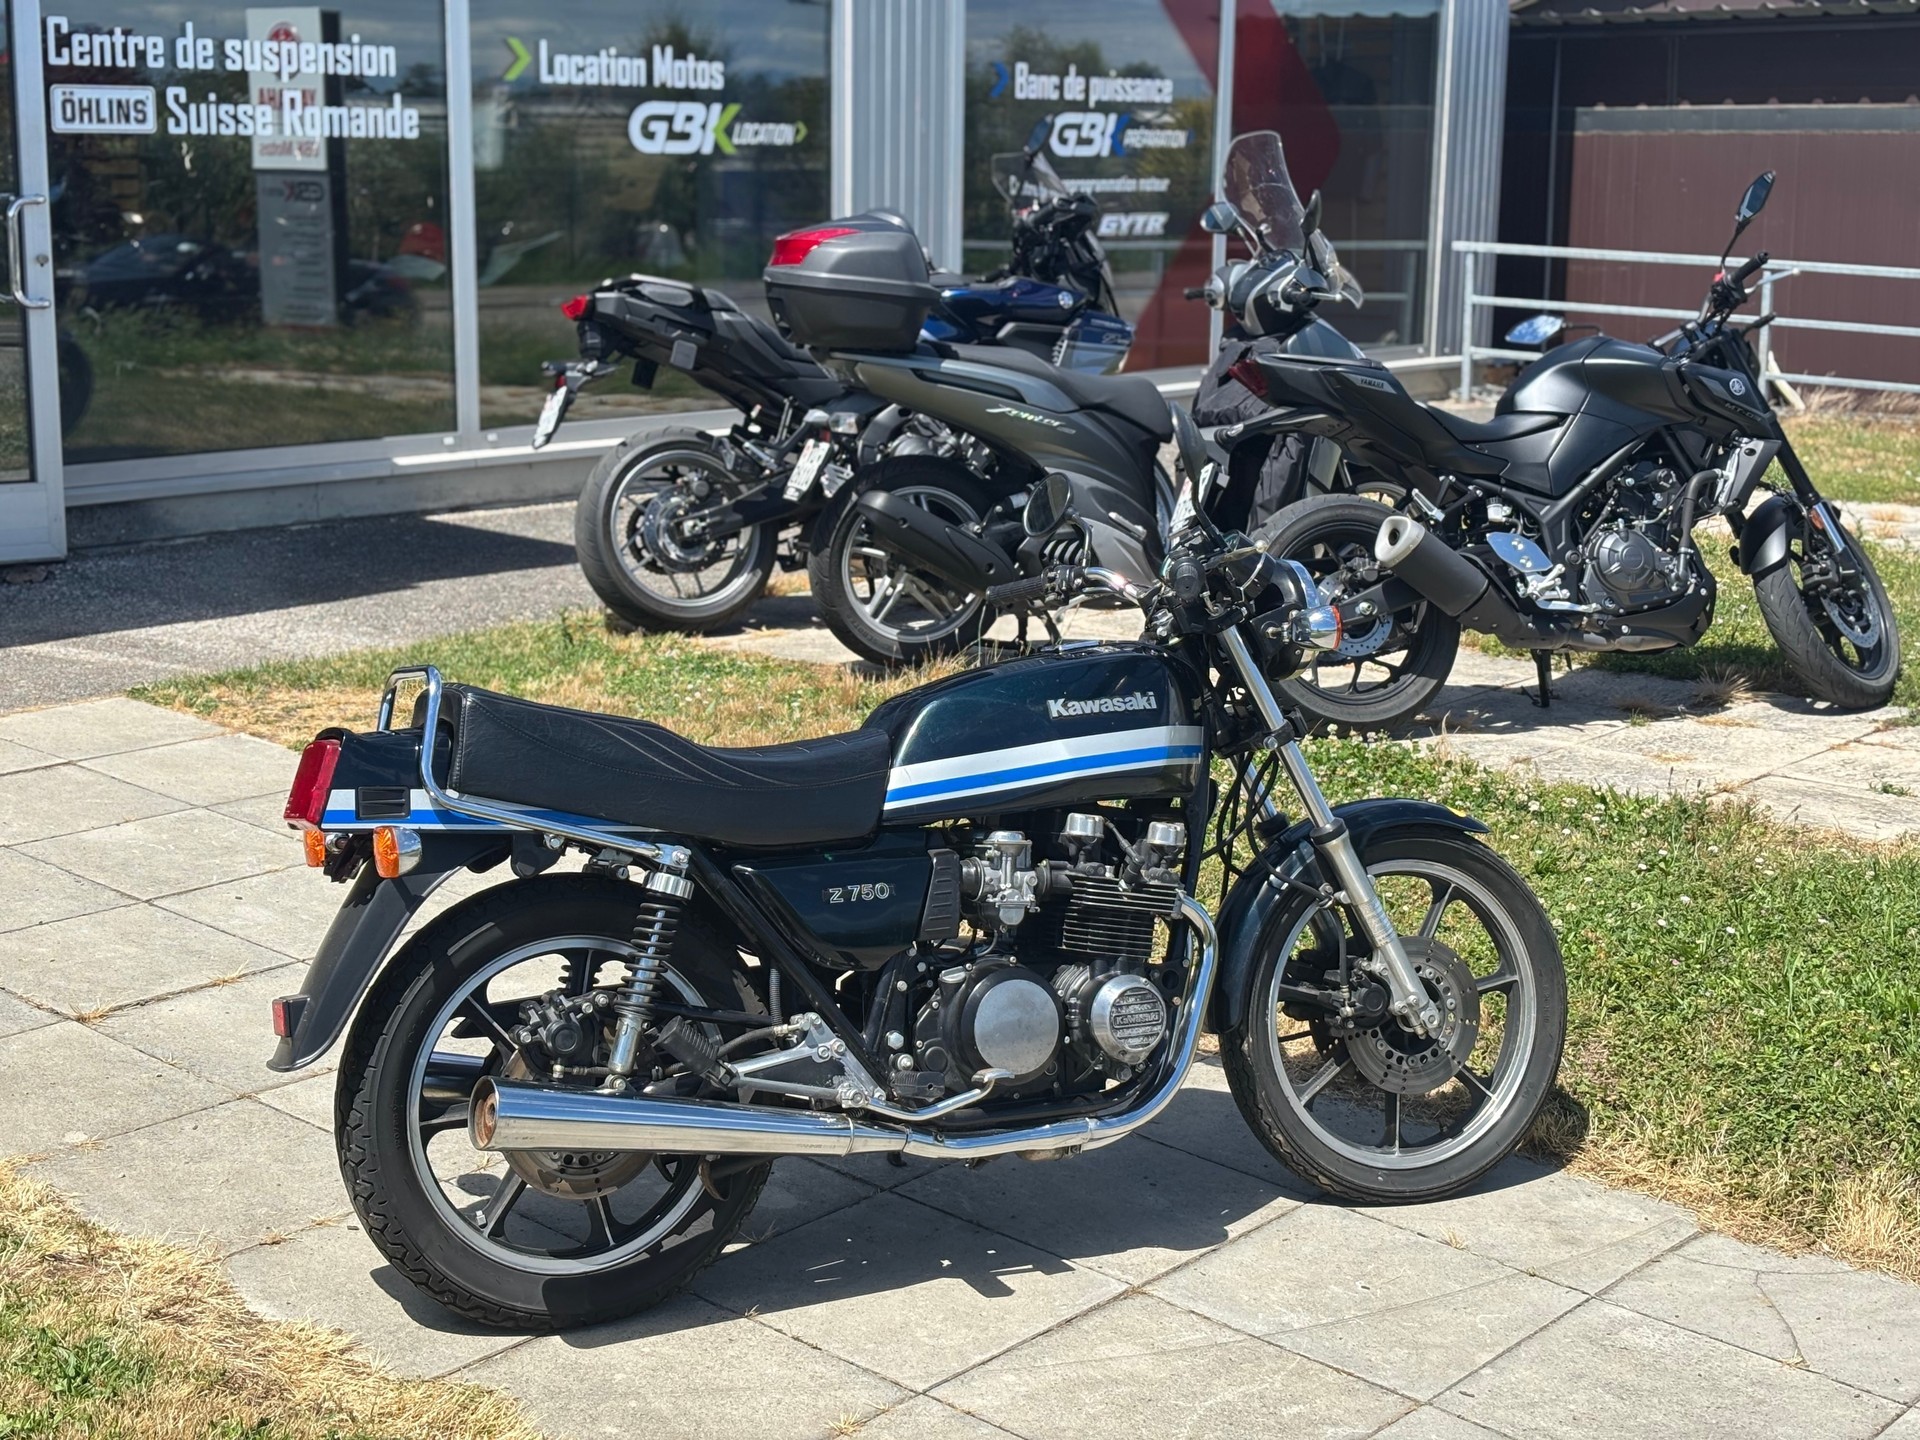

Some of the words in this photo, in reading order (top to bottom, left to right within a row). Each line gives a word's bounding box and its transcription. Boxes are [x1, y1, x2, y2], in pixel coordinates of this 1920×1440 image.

[46, 16, 165, 68] Centre
[176, 21, 214, 70] de
[224, 34, 397, 82] suspension
[539, 39, 647, 87] Location
[653, 45, 725, 90] Motos
[61, 90, 147, 124] ÖHLINS
[1015, 61, 1060, 100] Banc
[1064, 63, 1086, 100] de
[1088, 69, 1173, 109] puissance
[165, 86, 273, 136] Suisse
[282, 89, 420, 139] Romande
[627, 100, 743, 155] GBK
[732, 122, 795, 146] LOCATION
[1049, 111, 1131, 157] GBK
[1098, 212, 1170, 236] GYTR
[1047, 691, 1158, 719] Kawasaki
[829, 887, 844, 903] Z
[847, 882, 889, 902] 750
[1116, 1012, 1159, 1025] Kawasaki
